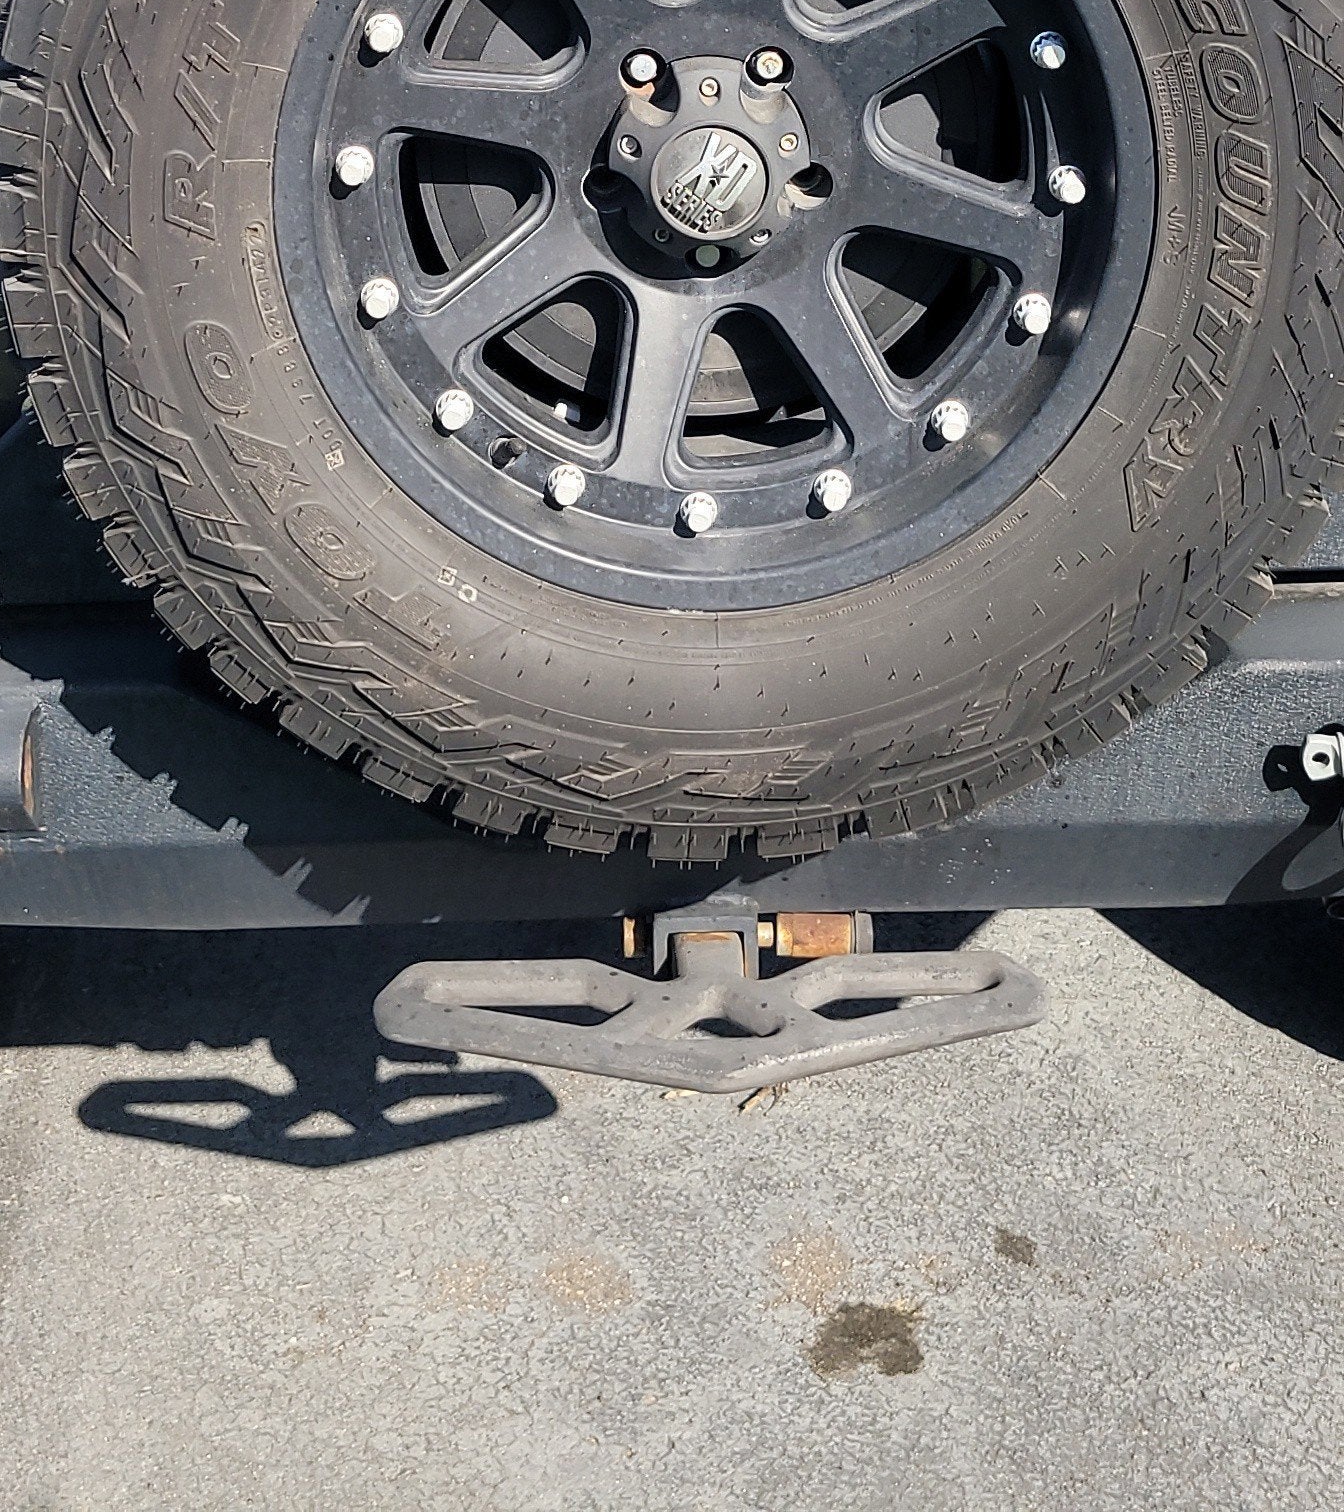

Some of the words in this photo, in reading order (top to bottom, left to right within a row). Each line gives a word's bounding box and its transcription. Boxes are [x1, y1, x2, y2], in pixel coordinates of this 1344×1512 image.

[663, 181, 724, 232] SERIES
[676, 131, 758, 213] XD
[185, 320, 445, 651] TOYO
